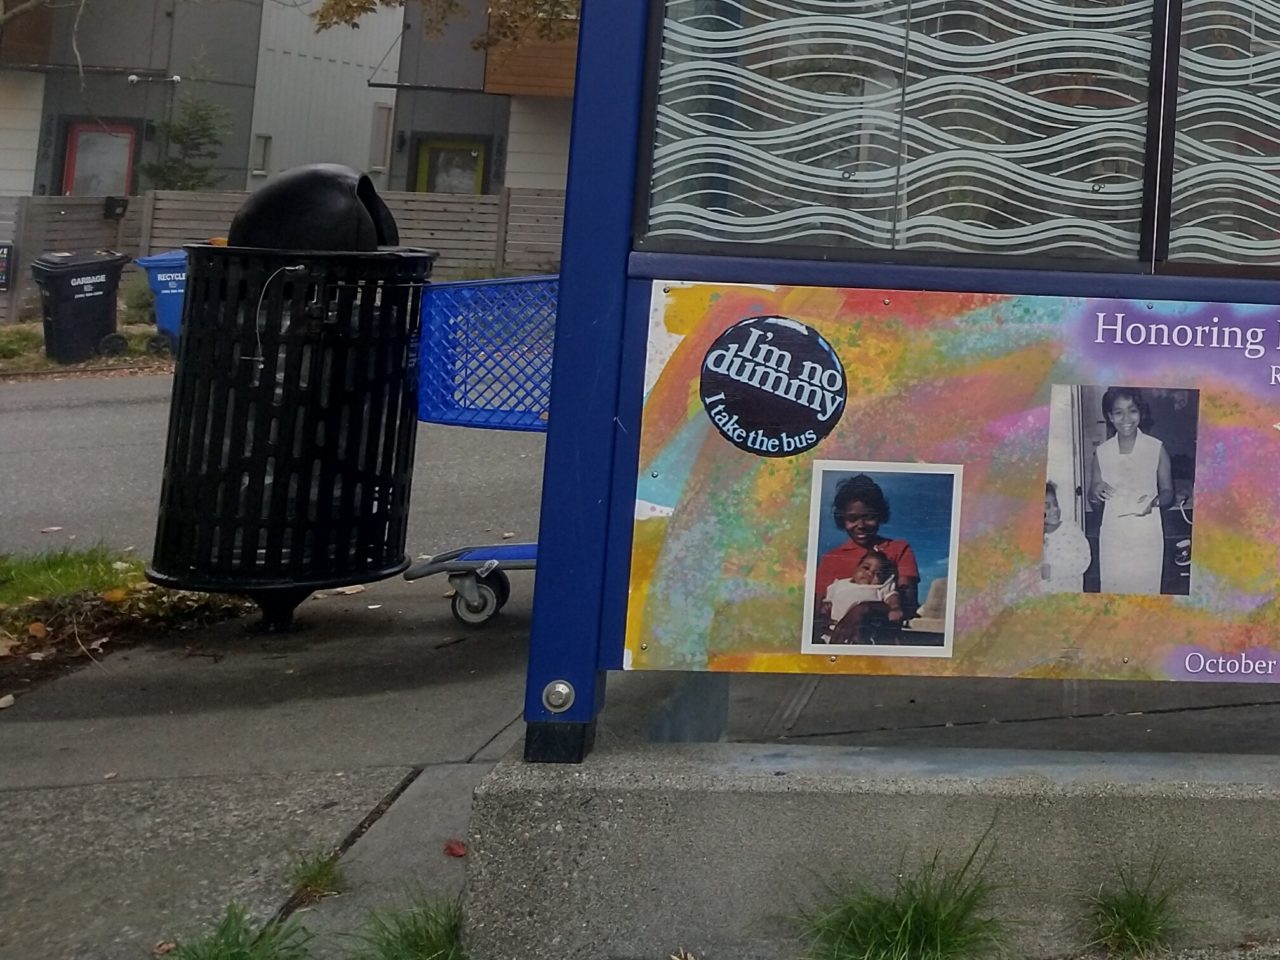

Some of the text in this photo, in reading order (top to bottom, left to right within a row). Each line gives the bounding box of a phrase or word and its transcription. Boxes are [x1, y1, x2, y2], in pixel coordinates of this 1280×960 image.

[71, 274, 106, 286] GARBAGE
[738, 327, 843, 392] I'm no
[1094, 312, 1267, 359] Honoring
[706, 343, 844, 422] dummy
[705, 392, 817, 452] I take the bus
[1185, 652, 1277, 674] October
